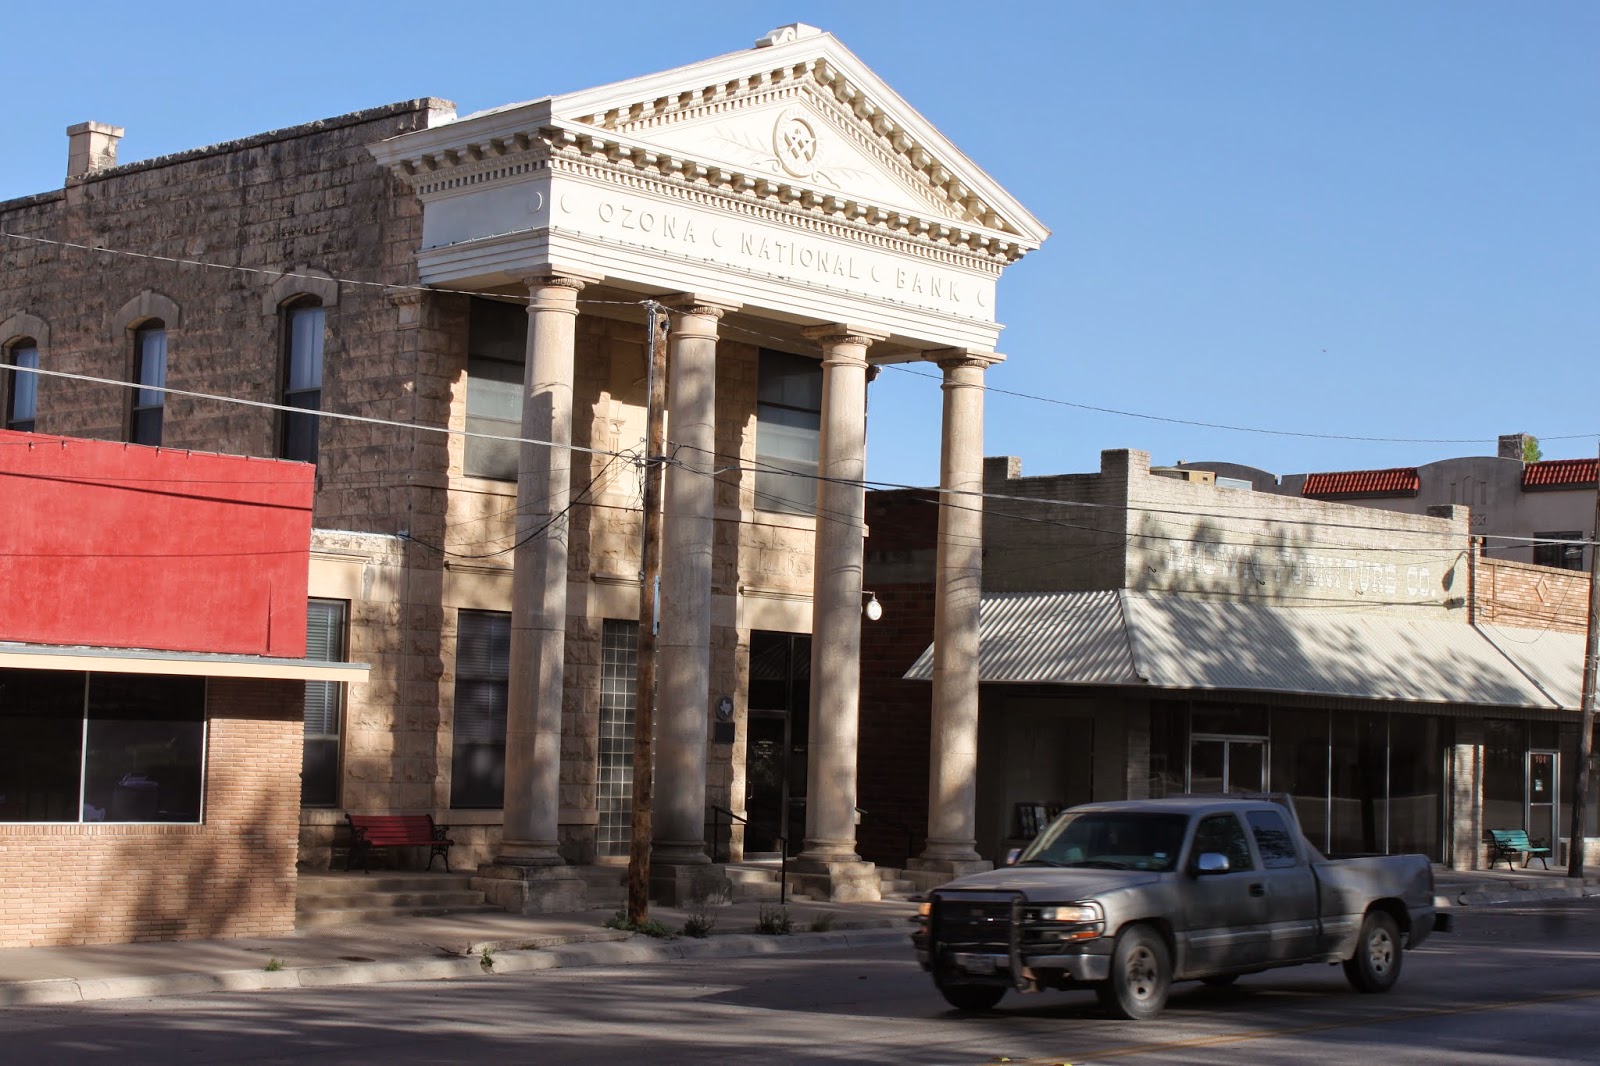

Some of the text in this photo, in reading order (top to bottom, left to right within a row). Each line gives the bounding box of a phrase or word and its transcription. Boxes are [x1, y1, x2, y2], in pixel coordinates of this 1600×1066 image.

[598, 201, 960, 302] OZONA NATIONAL BANK
[1168, 540, 1261, 580] BROWN
[1275, 550, 1396, 595] FURNITURE
